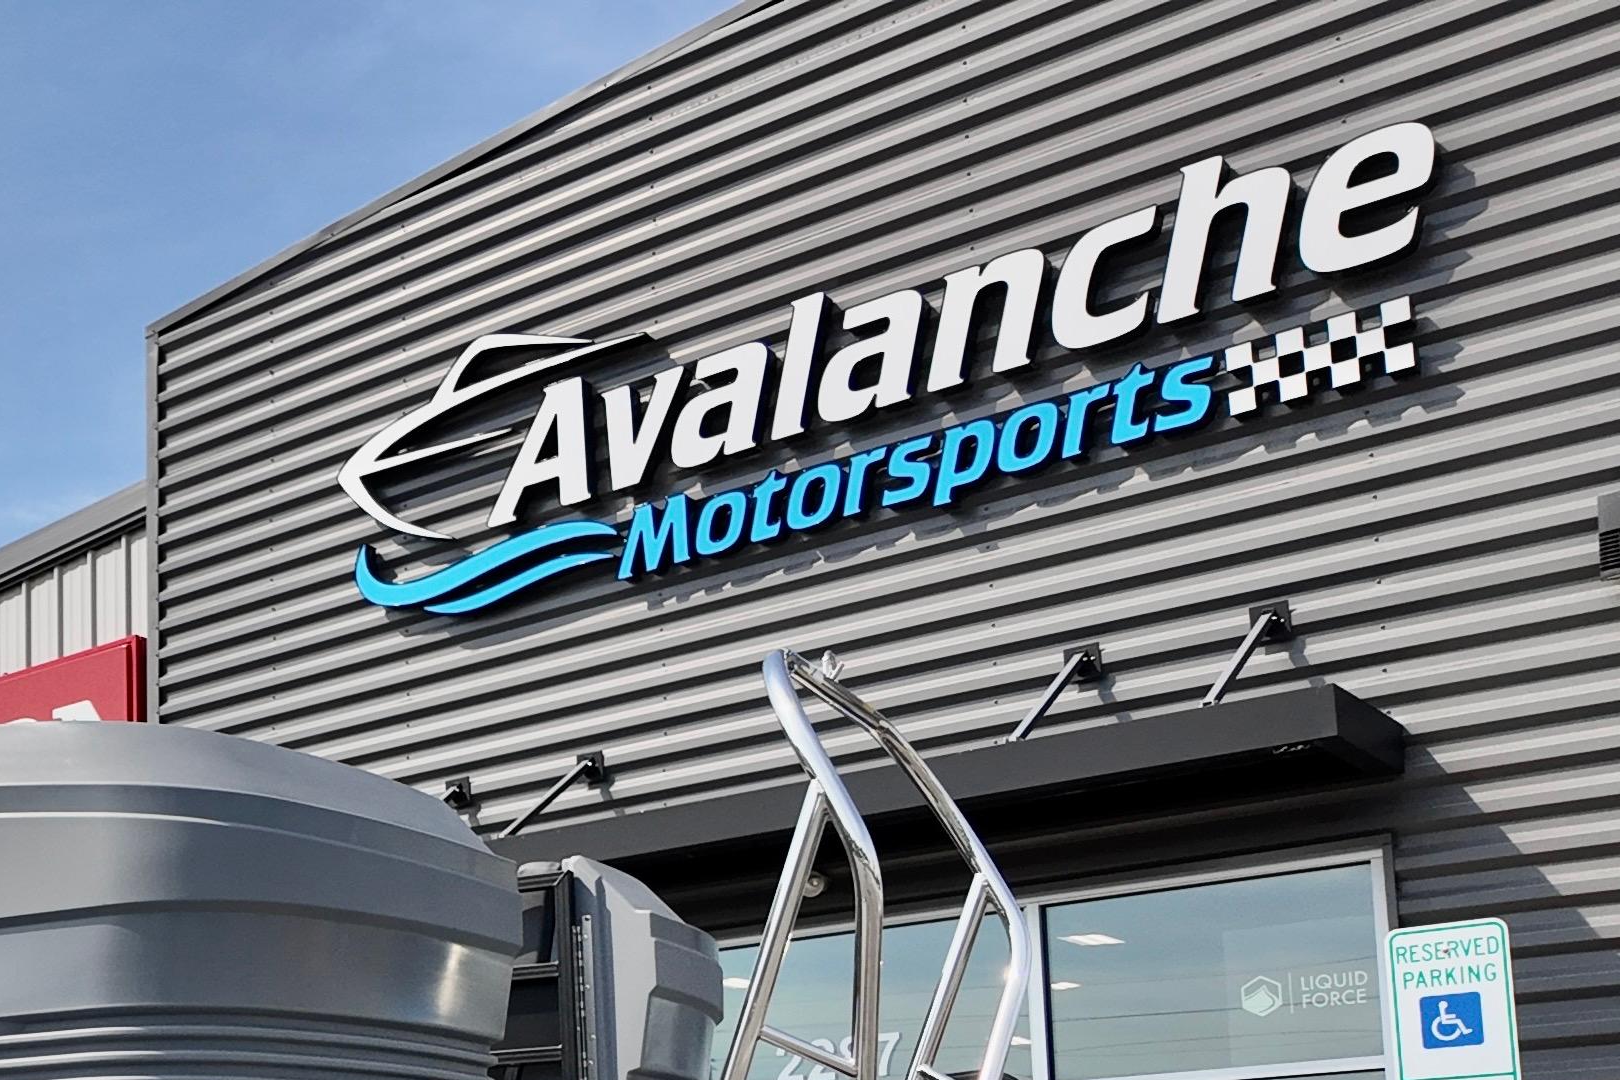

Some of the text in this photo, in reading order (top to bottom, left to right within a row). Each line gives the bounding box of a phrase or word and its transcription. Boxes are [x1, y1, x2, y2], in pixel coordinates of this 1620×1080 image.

[486, 120, 1437, 528] Avalanche
[615, 347, 1214, 581] Motorsports
[1396, 936, 1500, 964] RESERVED
[1300, 970, 1368, 991] LIQUID
[1403, 962, 1497, 990] PARKING
[1302, 988, 1368, 1009] FORCE
